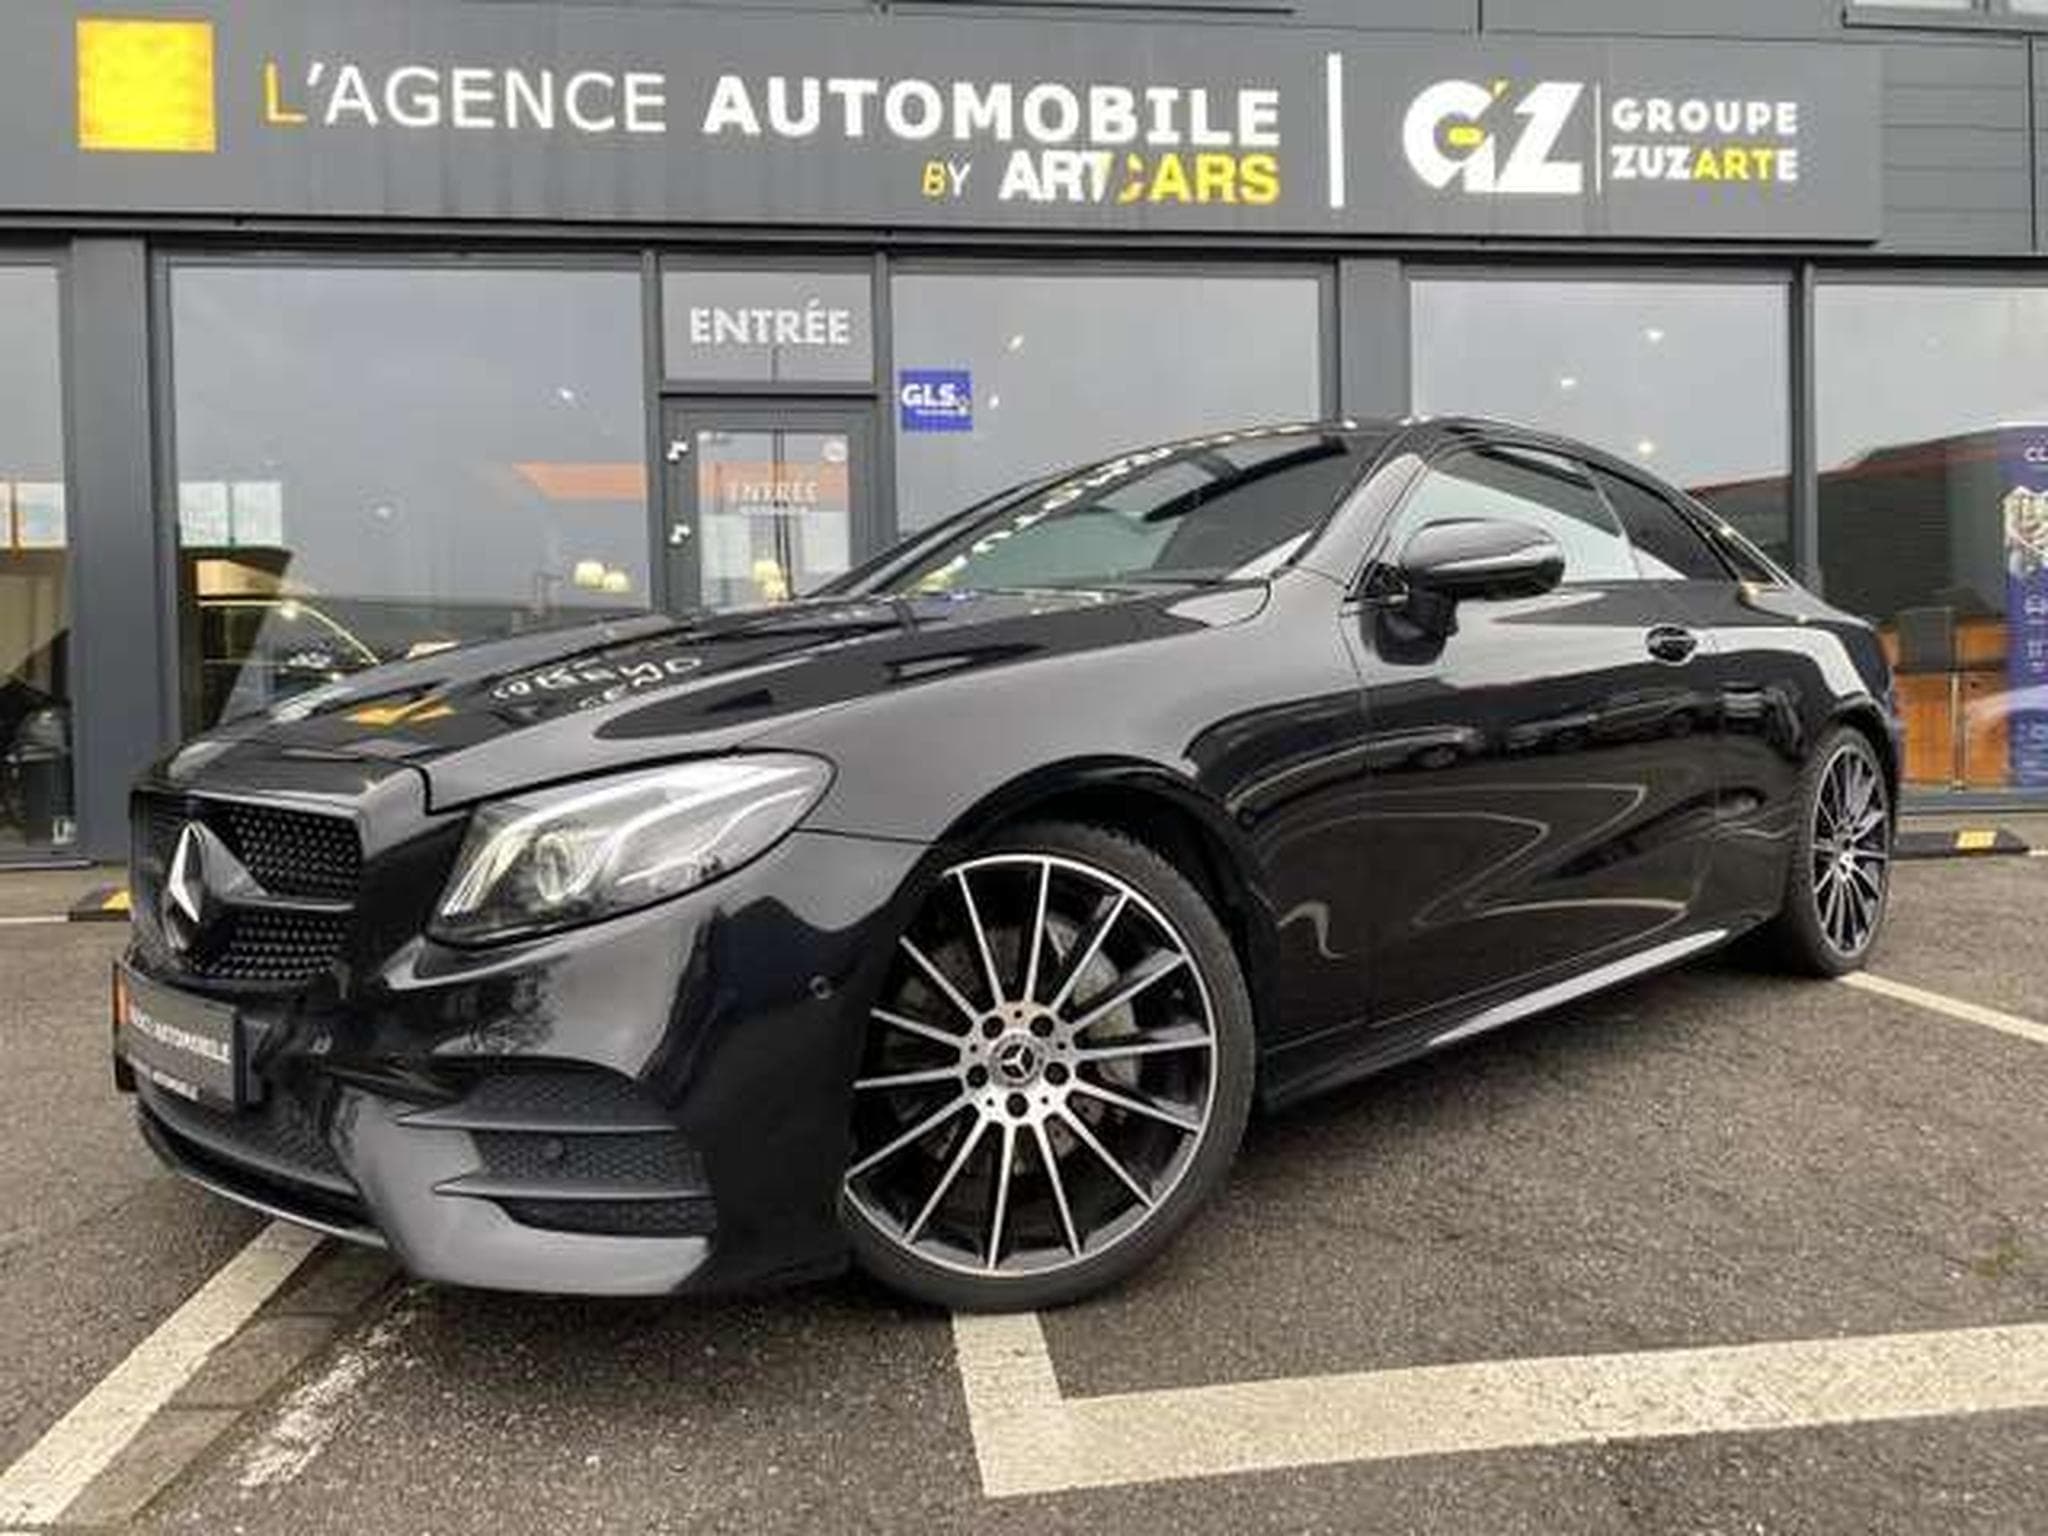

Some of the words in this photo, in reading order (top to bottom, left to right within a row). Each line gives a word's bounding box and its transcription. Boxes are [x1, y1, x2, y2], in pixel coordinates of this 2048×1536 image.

[265, 62, 667, 132] L'AGENCE
[702, 74, 1281, 147] AUTOMOBILE
[1611, 98, 1798, 134] GROUPE
[921, 160, 972, 198] BY
[1610, 144, 1798, 181] ZUZARTE
[689, 297, 851, 345] ENTRÉE
[902, 383, 956, 408] GLS
